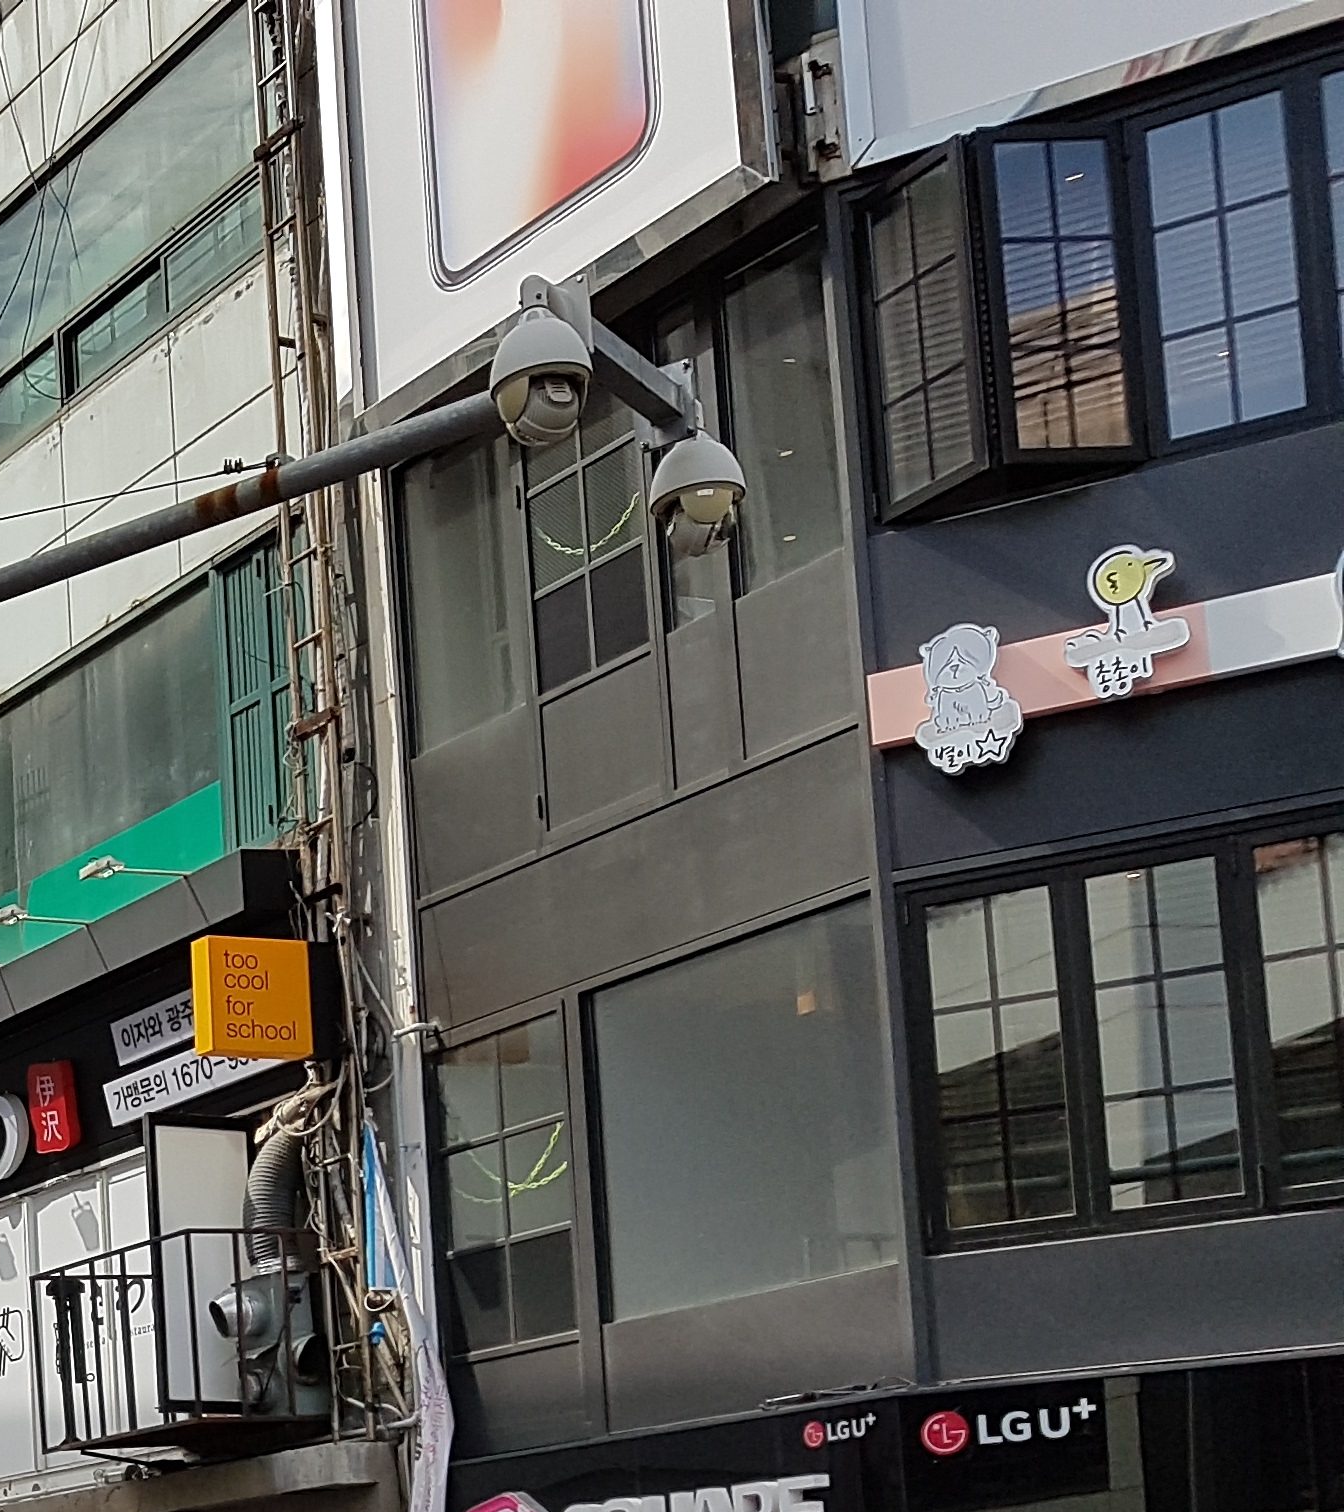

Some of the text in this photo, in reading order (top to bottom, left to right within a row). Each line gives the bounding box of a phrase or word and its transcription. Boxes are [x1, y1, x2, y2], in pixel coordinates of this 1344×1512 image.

[1094, 655, 1149, 692] 총총이
[934, 735, 970, 768] 별이
[223, 949, 259, 970] too
[223, 970, 270, 991] cool
[225, 995, 255, 1016] for
[120, 1012, 163, 1050] 이자와
[225, 1018, 298, 1041] school
[34, 1075, 62, 1143] 伊沢
[112, 1075, 170, 1113] 가맹문의
